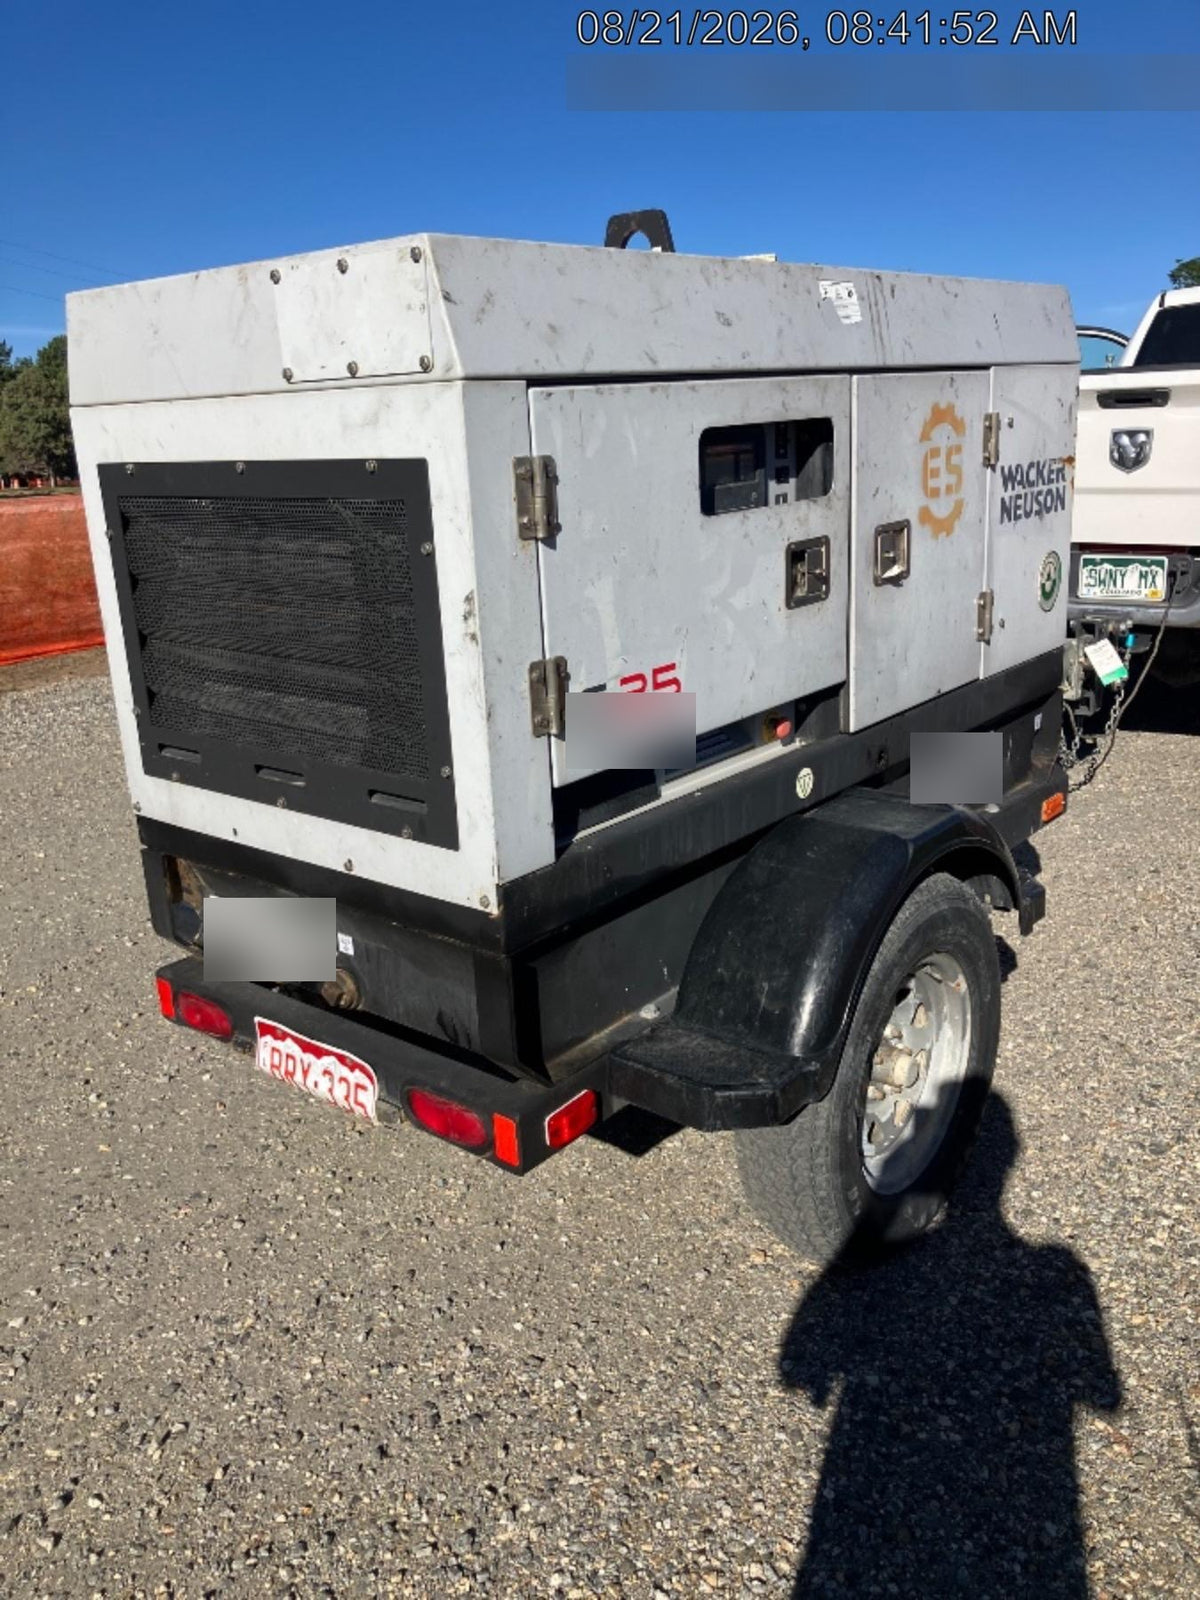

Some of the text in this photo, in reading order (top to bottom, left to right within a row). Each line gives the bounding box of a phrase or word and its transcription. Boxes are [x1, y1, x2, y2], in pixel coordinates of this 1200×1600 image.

[921, 444, 963, 498] ES
[1000, 458, 1067, 493] WACKER
[1000, 485, 1066, 524] NEUSON
